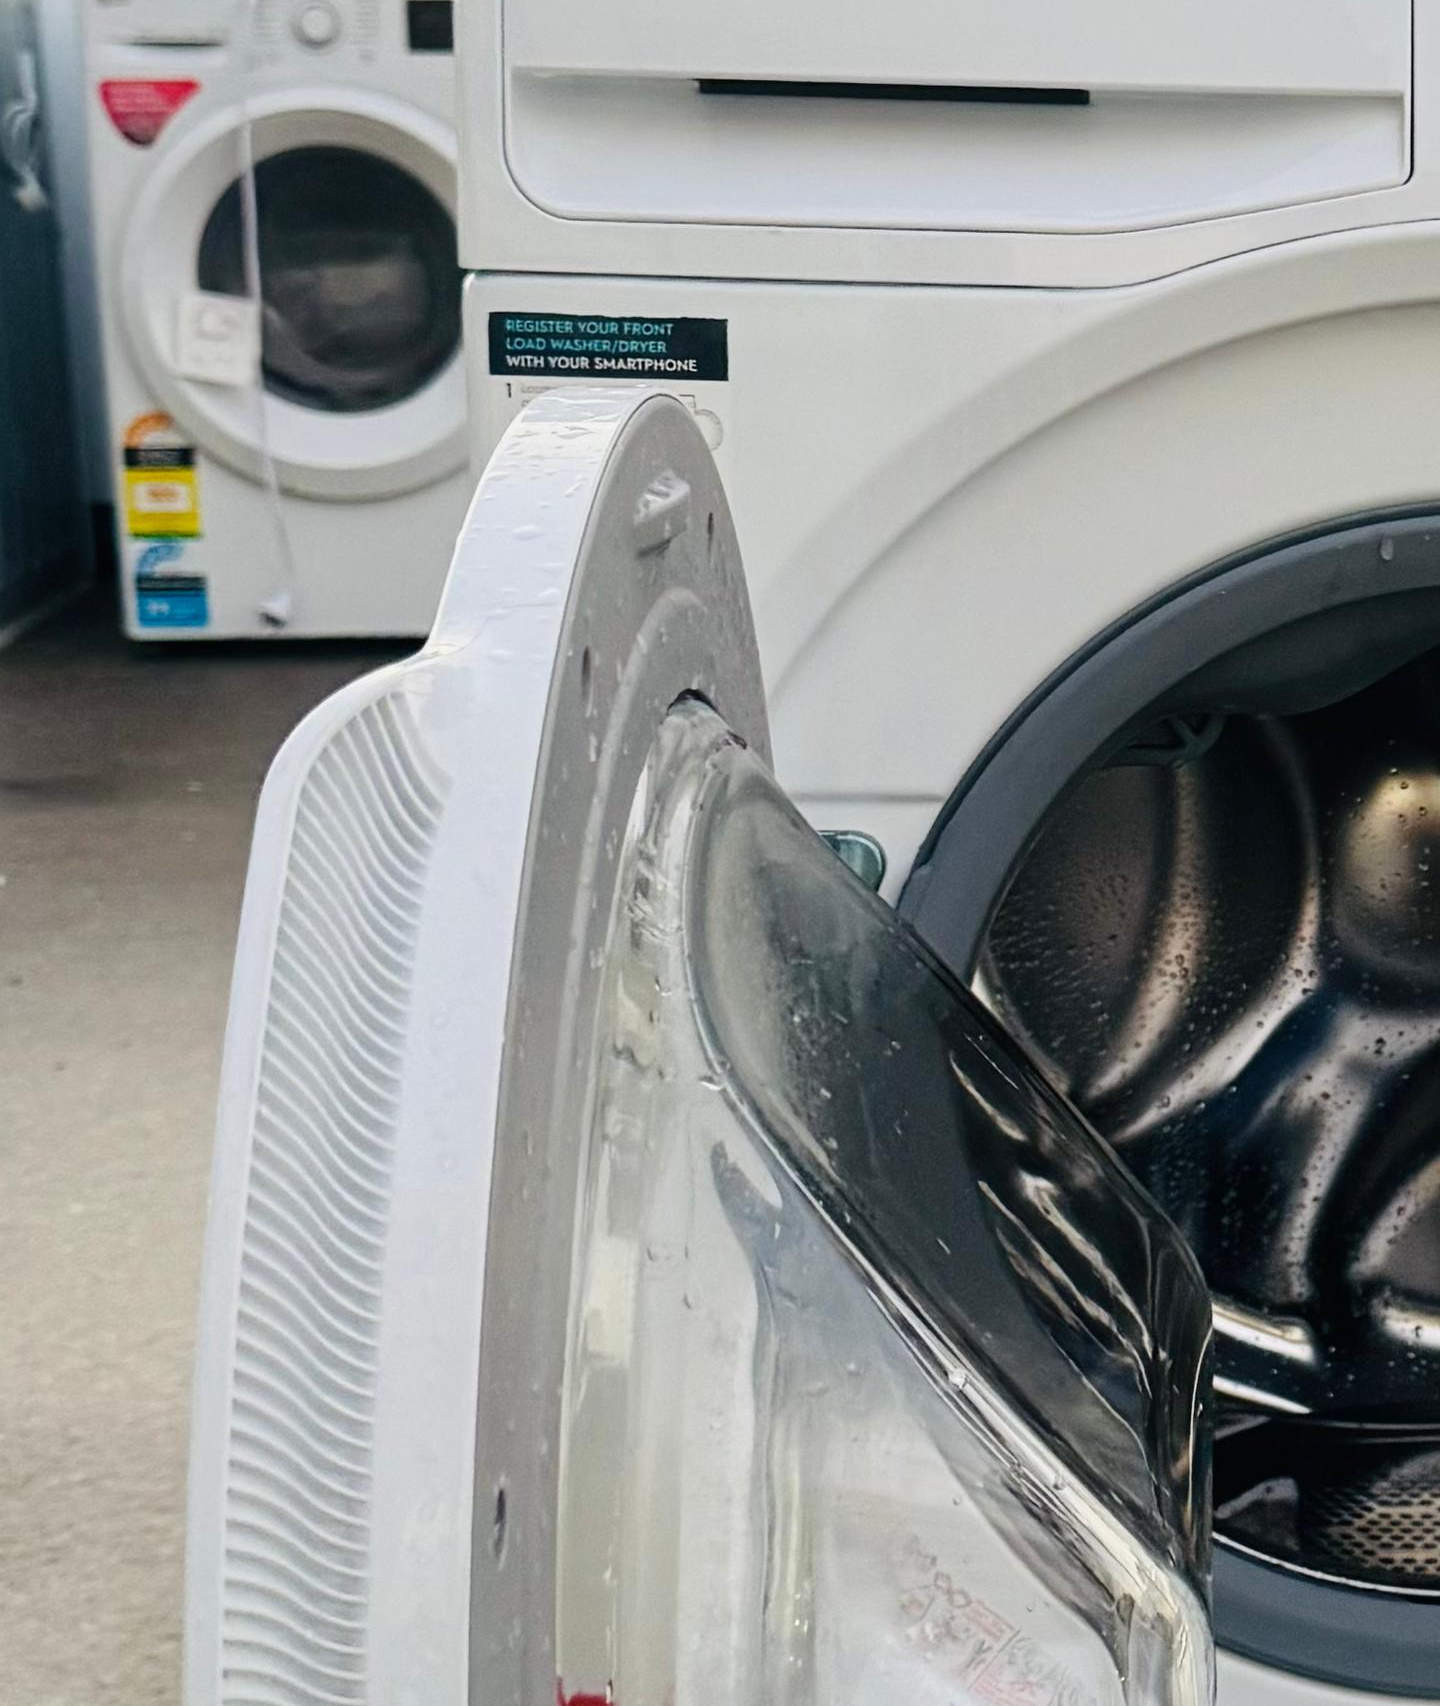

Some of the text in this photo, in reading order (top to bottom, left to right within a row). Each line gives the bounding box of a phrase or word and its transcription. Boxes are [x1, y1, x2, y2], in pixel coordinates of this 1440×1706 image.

[506, 320, 674, 335] REGISTER YOUR FRONT
[506, 338, 666, 353] LOAD WASHER/DRYER
[506, 355, 698, 372] WITH YOUR SMARTPHONE
